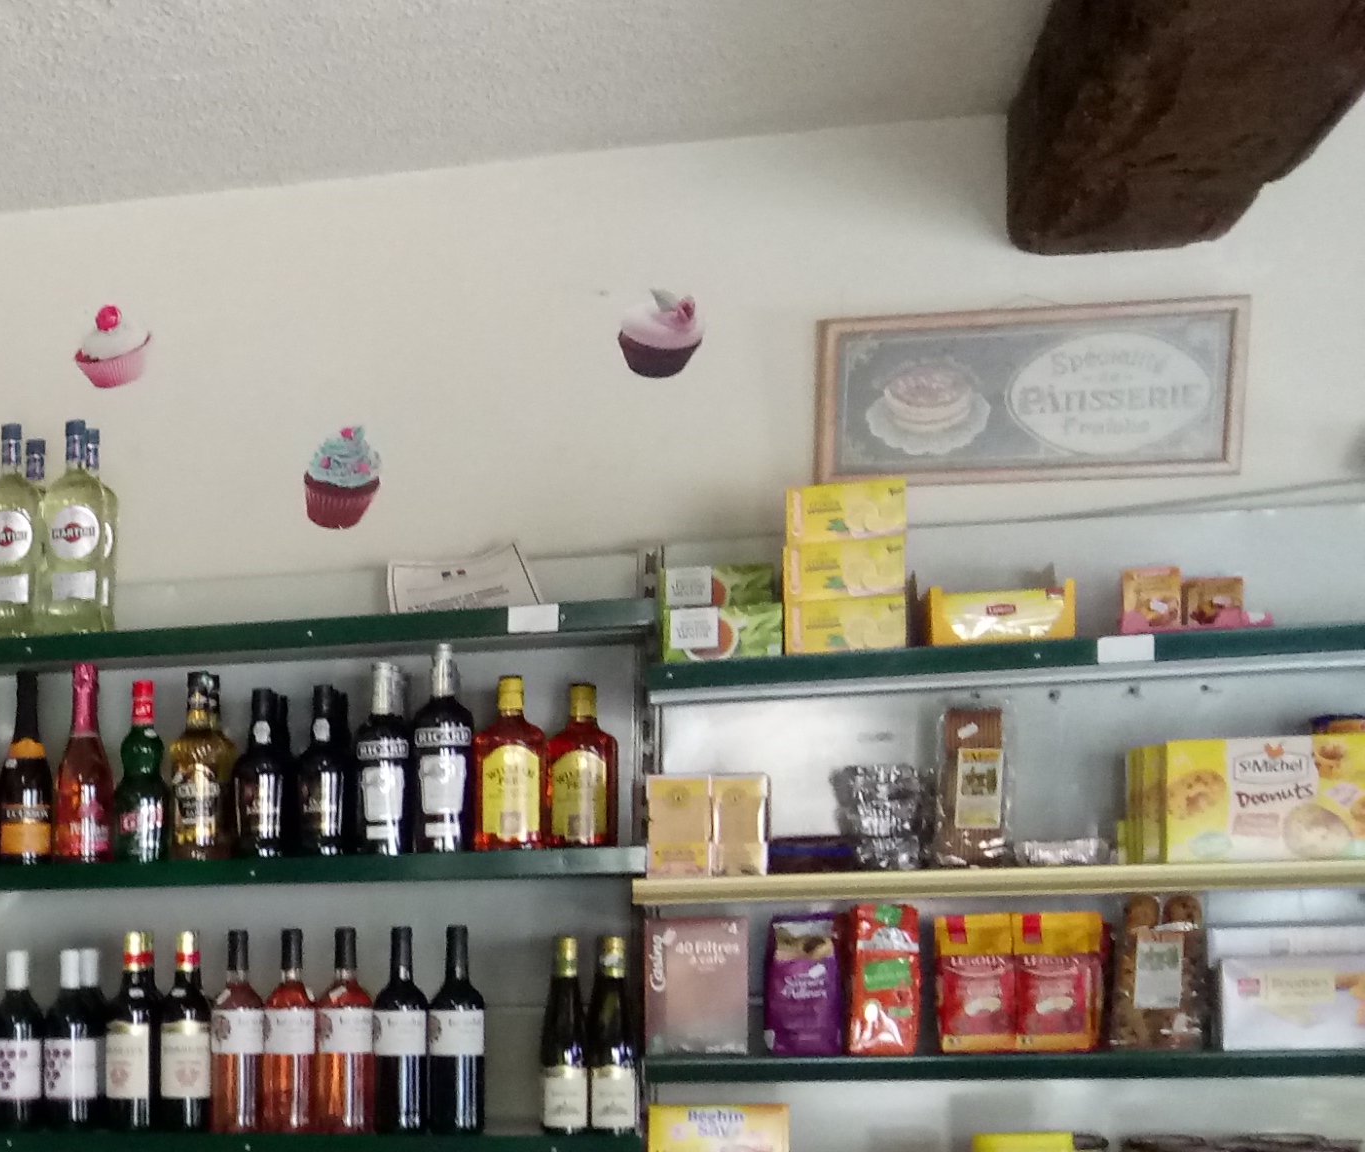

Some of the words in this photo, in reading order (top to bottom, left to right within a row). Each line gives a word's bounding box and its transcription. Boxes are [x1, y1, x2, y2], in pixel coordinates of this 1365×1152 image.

[51, 525, 97, 540] MARTINI
[418, 730, 470, 744] RICARD
[359, 744, 408, 758] RICARD
[1235, 783, 1314, 808] Doonuts
